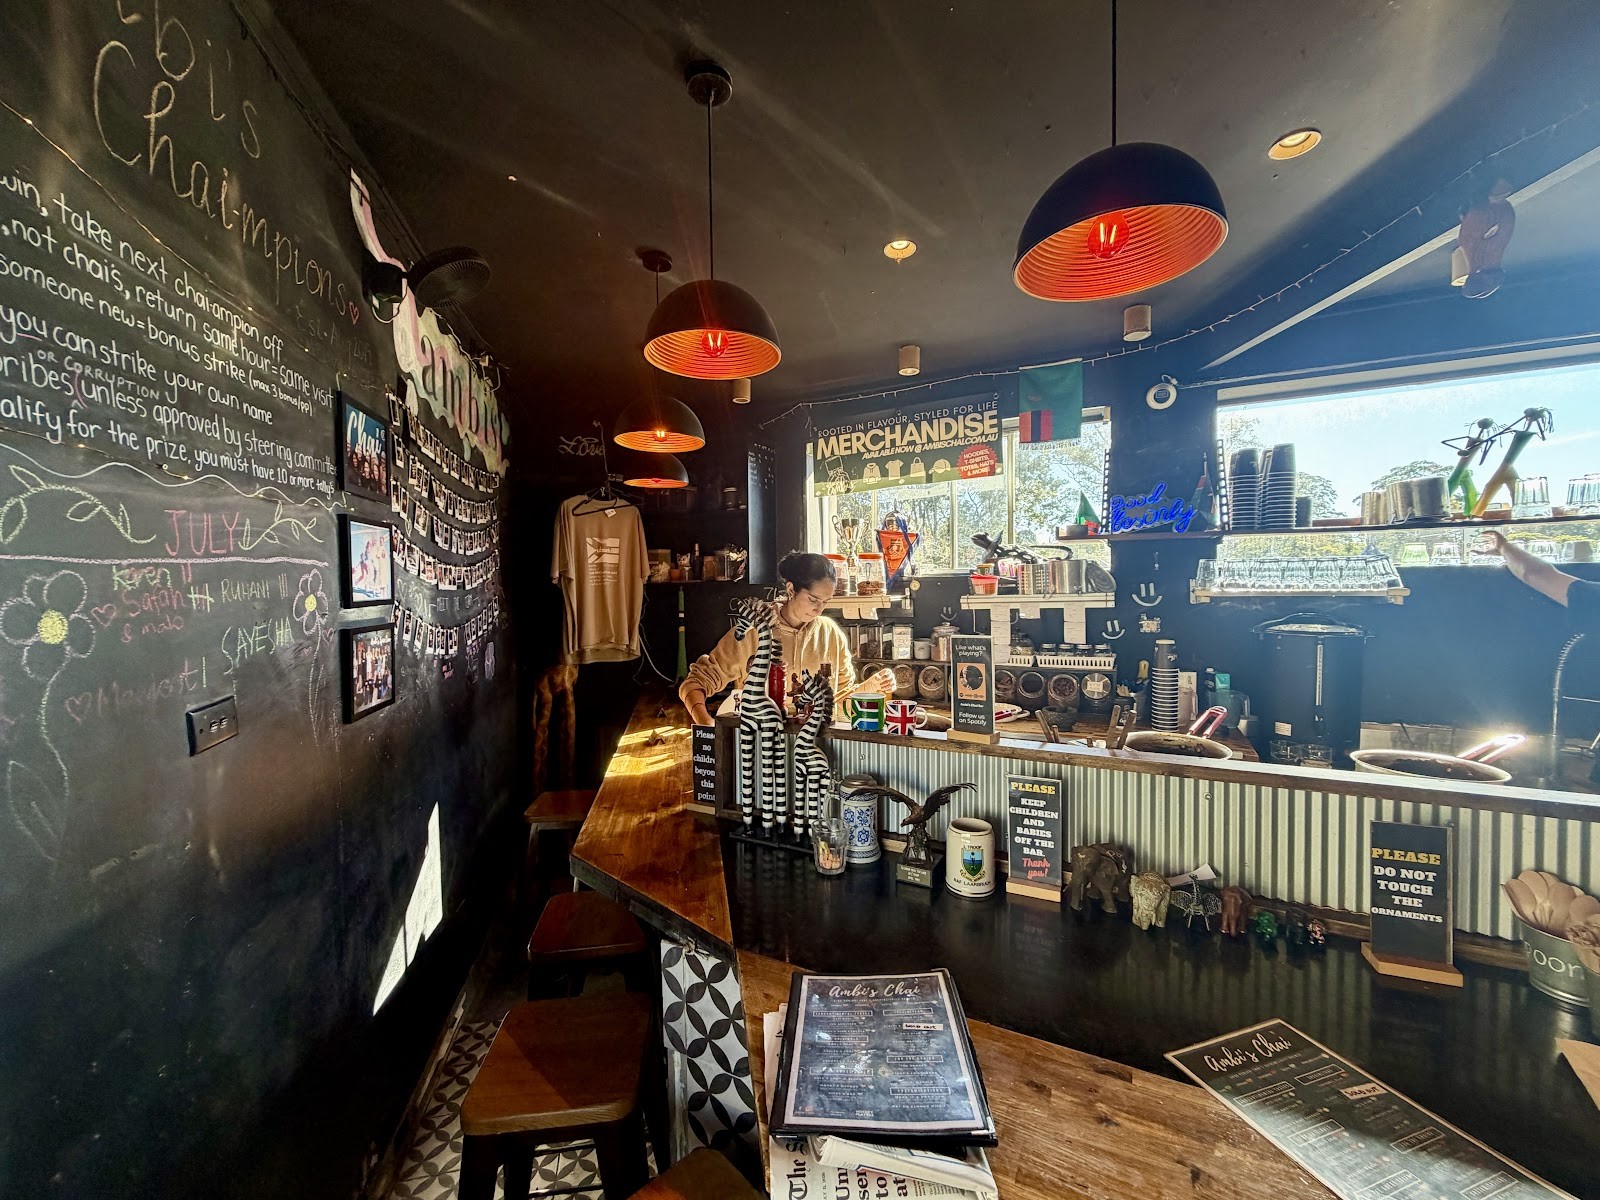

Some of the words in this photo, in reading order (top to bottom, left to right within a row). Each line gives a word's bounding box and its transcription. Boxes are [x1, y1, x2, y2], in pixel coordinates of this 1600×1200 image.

[52, 193, 113, 251] take
[119, 240, 169, 284] next
[263, 334, 284, 363] off
[99, 299, 135, 327] new
[147, 316, 201, 363] bonus
[204, 351, 246, 385] strike
[135, 285, 197, 332] return
[203, 321, 239, 357] same
[241, 338, 271, 374] hour
[279, 365, 311, 397] same
[312, 384, 335, 409] visit
[0, 305, 47, 344] you
[53, 326, 97, 359] can
[100, 340, 156, 382] strike
[164, 370, 204, 404] your
[208, 385, 240, 410] own
[243, 402, 273, 426] name
[37, 349, 58, 363] OR
[64, 355, 160, 400] CORRUPTION
[818, 425, 853, 438] ROOTED
[855, 421, 865, 431] IN
[867, 415, 911, 430] FLAVOUR,
[914, 408, 949, 422] STYLED
[953, 404, 974, 415] FOR
[978, 400, 998, 412] LIFE
[153, 404, 220, 441] approved
[222, 417, 242, 458] by
[244, 429, 293, 468] steering
[816, 410, 999, 461] MERCHANDISE
[67, 409, 102, 438] for
[107, 420, 140, 450] the
[194, 449, 219, 472] you
[220, 452, 250, 473] must
[251, 458, 275, 481] have
[277, 468, 288, 485] 10
[894, 444, 915, 454] NOW
[163, 509, 240, 556] JULY
[958, 650, 983, 658] playing?
[958, 711, 977, 719] Follow
[967, 717, 987, 727] Spotify
[694, 766, 715, 776] beyon
[701, 779, 714, 788] this
[1010, 781, 1056, 795] PLEASE
[1020, 797, 1047, 808] KEEP
[1009, 806, 1059, 820] CHILDREN
[1022, 817, 1045, 828] AND
[1016, 826, 1052, 839] BABIES
[1014, 836, 1033, 845] OFF
[1033, 838, 1055, 849] THE
[1022, 847, 1046, 857] BAR.
[1371, 847, 1441, 866] PLEASE
[1022, 857, 1051, 868] Thank
[1027, 868, 1049, 880] you!
[1373, 865, 1396, 877] DO
[1400, 869, 1437, 883] NOT
[1377, 879, 1434, 896] TOUCH
[1391, 895, 1423, 908] THE
[1371, 907, 1443, 923] ORNAMENTS
[829, 984, 879, 998] Ambi's
[884, 982, 920, 997] Chai
[1251, 1032, 1292, 1058] Chai
[875, 1176, 889, 1199] to
[893, 1175, 908, 1197] at
